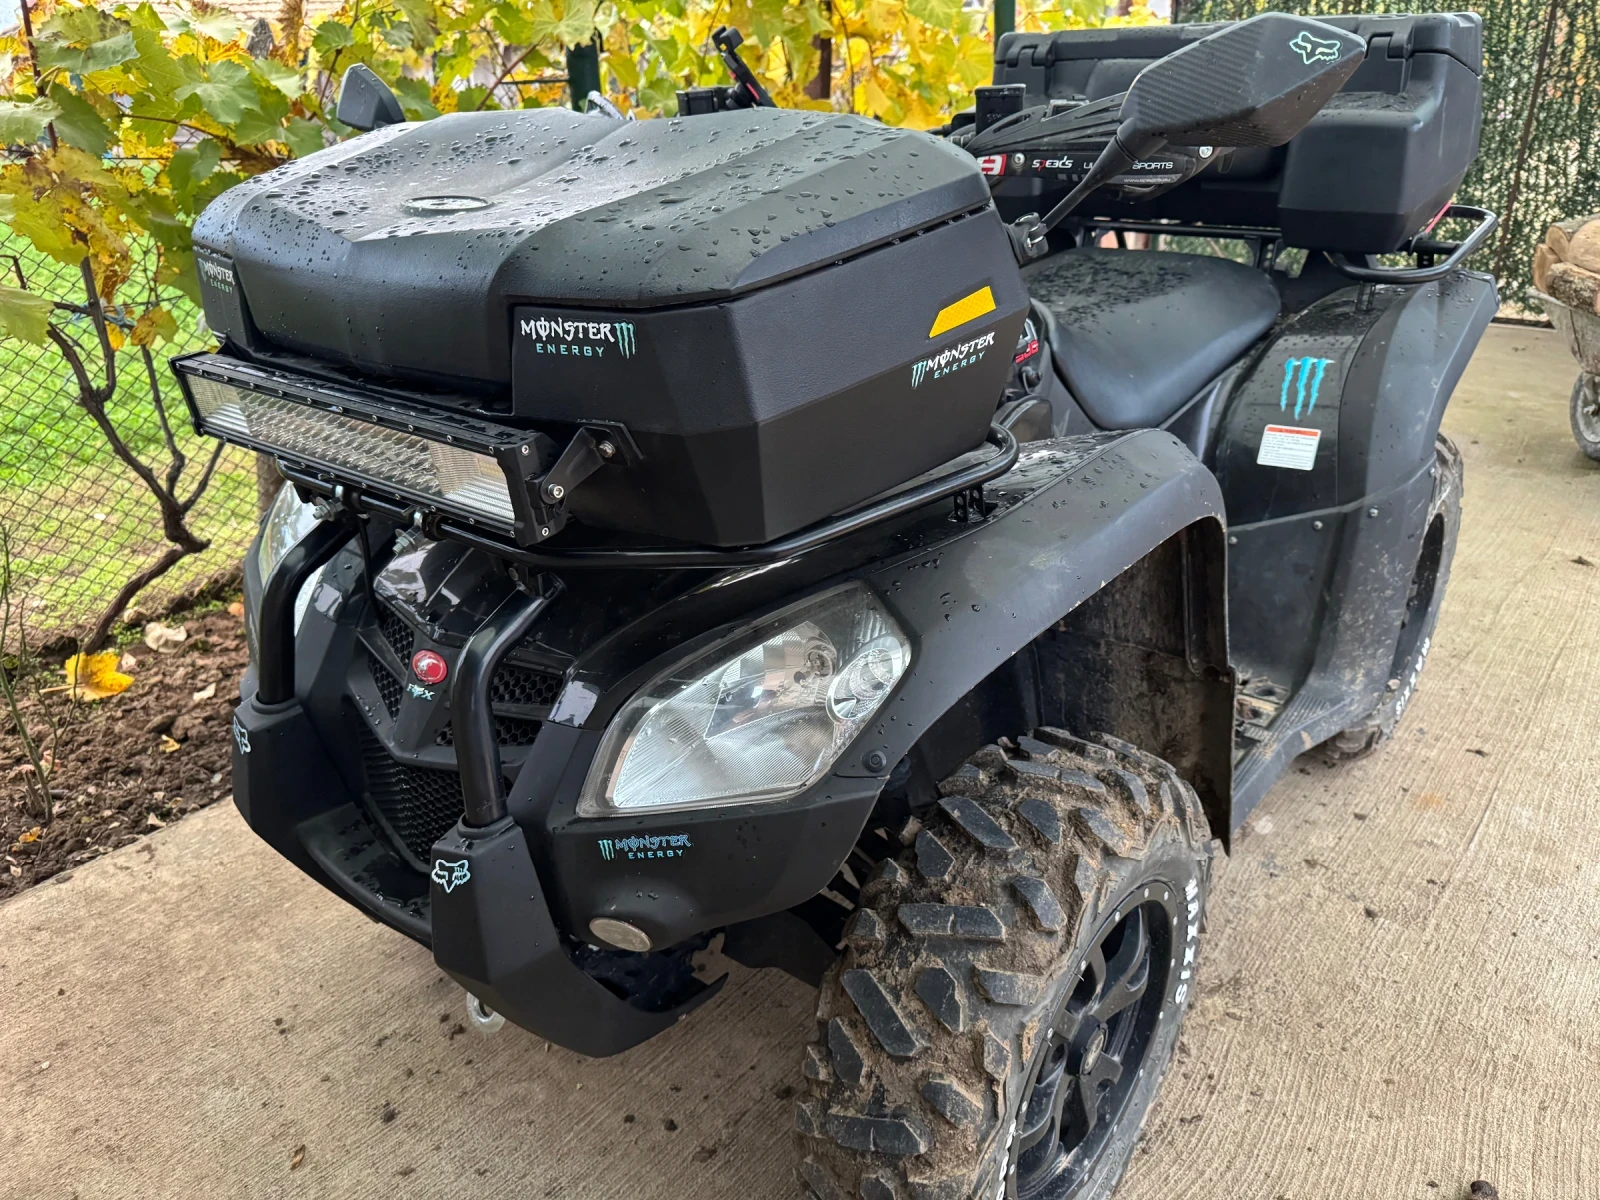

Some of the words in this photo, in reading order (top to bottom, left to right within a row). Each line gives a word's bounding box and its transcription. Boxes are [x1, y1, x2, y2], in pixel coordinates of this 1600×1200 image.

[1132, 161, 1174, 170] SPORTS
[520, 316, 616, 342] MONSTER
[535, 342, 605, 358] ENERGY
[926, 331, 996, 372] MONSTER
[933, 350, 985, 379] ENERGY
[614, 834, 692, 852] MONSTER
[628, 849, 684, 860] ENERGY
[1174, 877, 1199, 1005] MAXXIS
